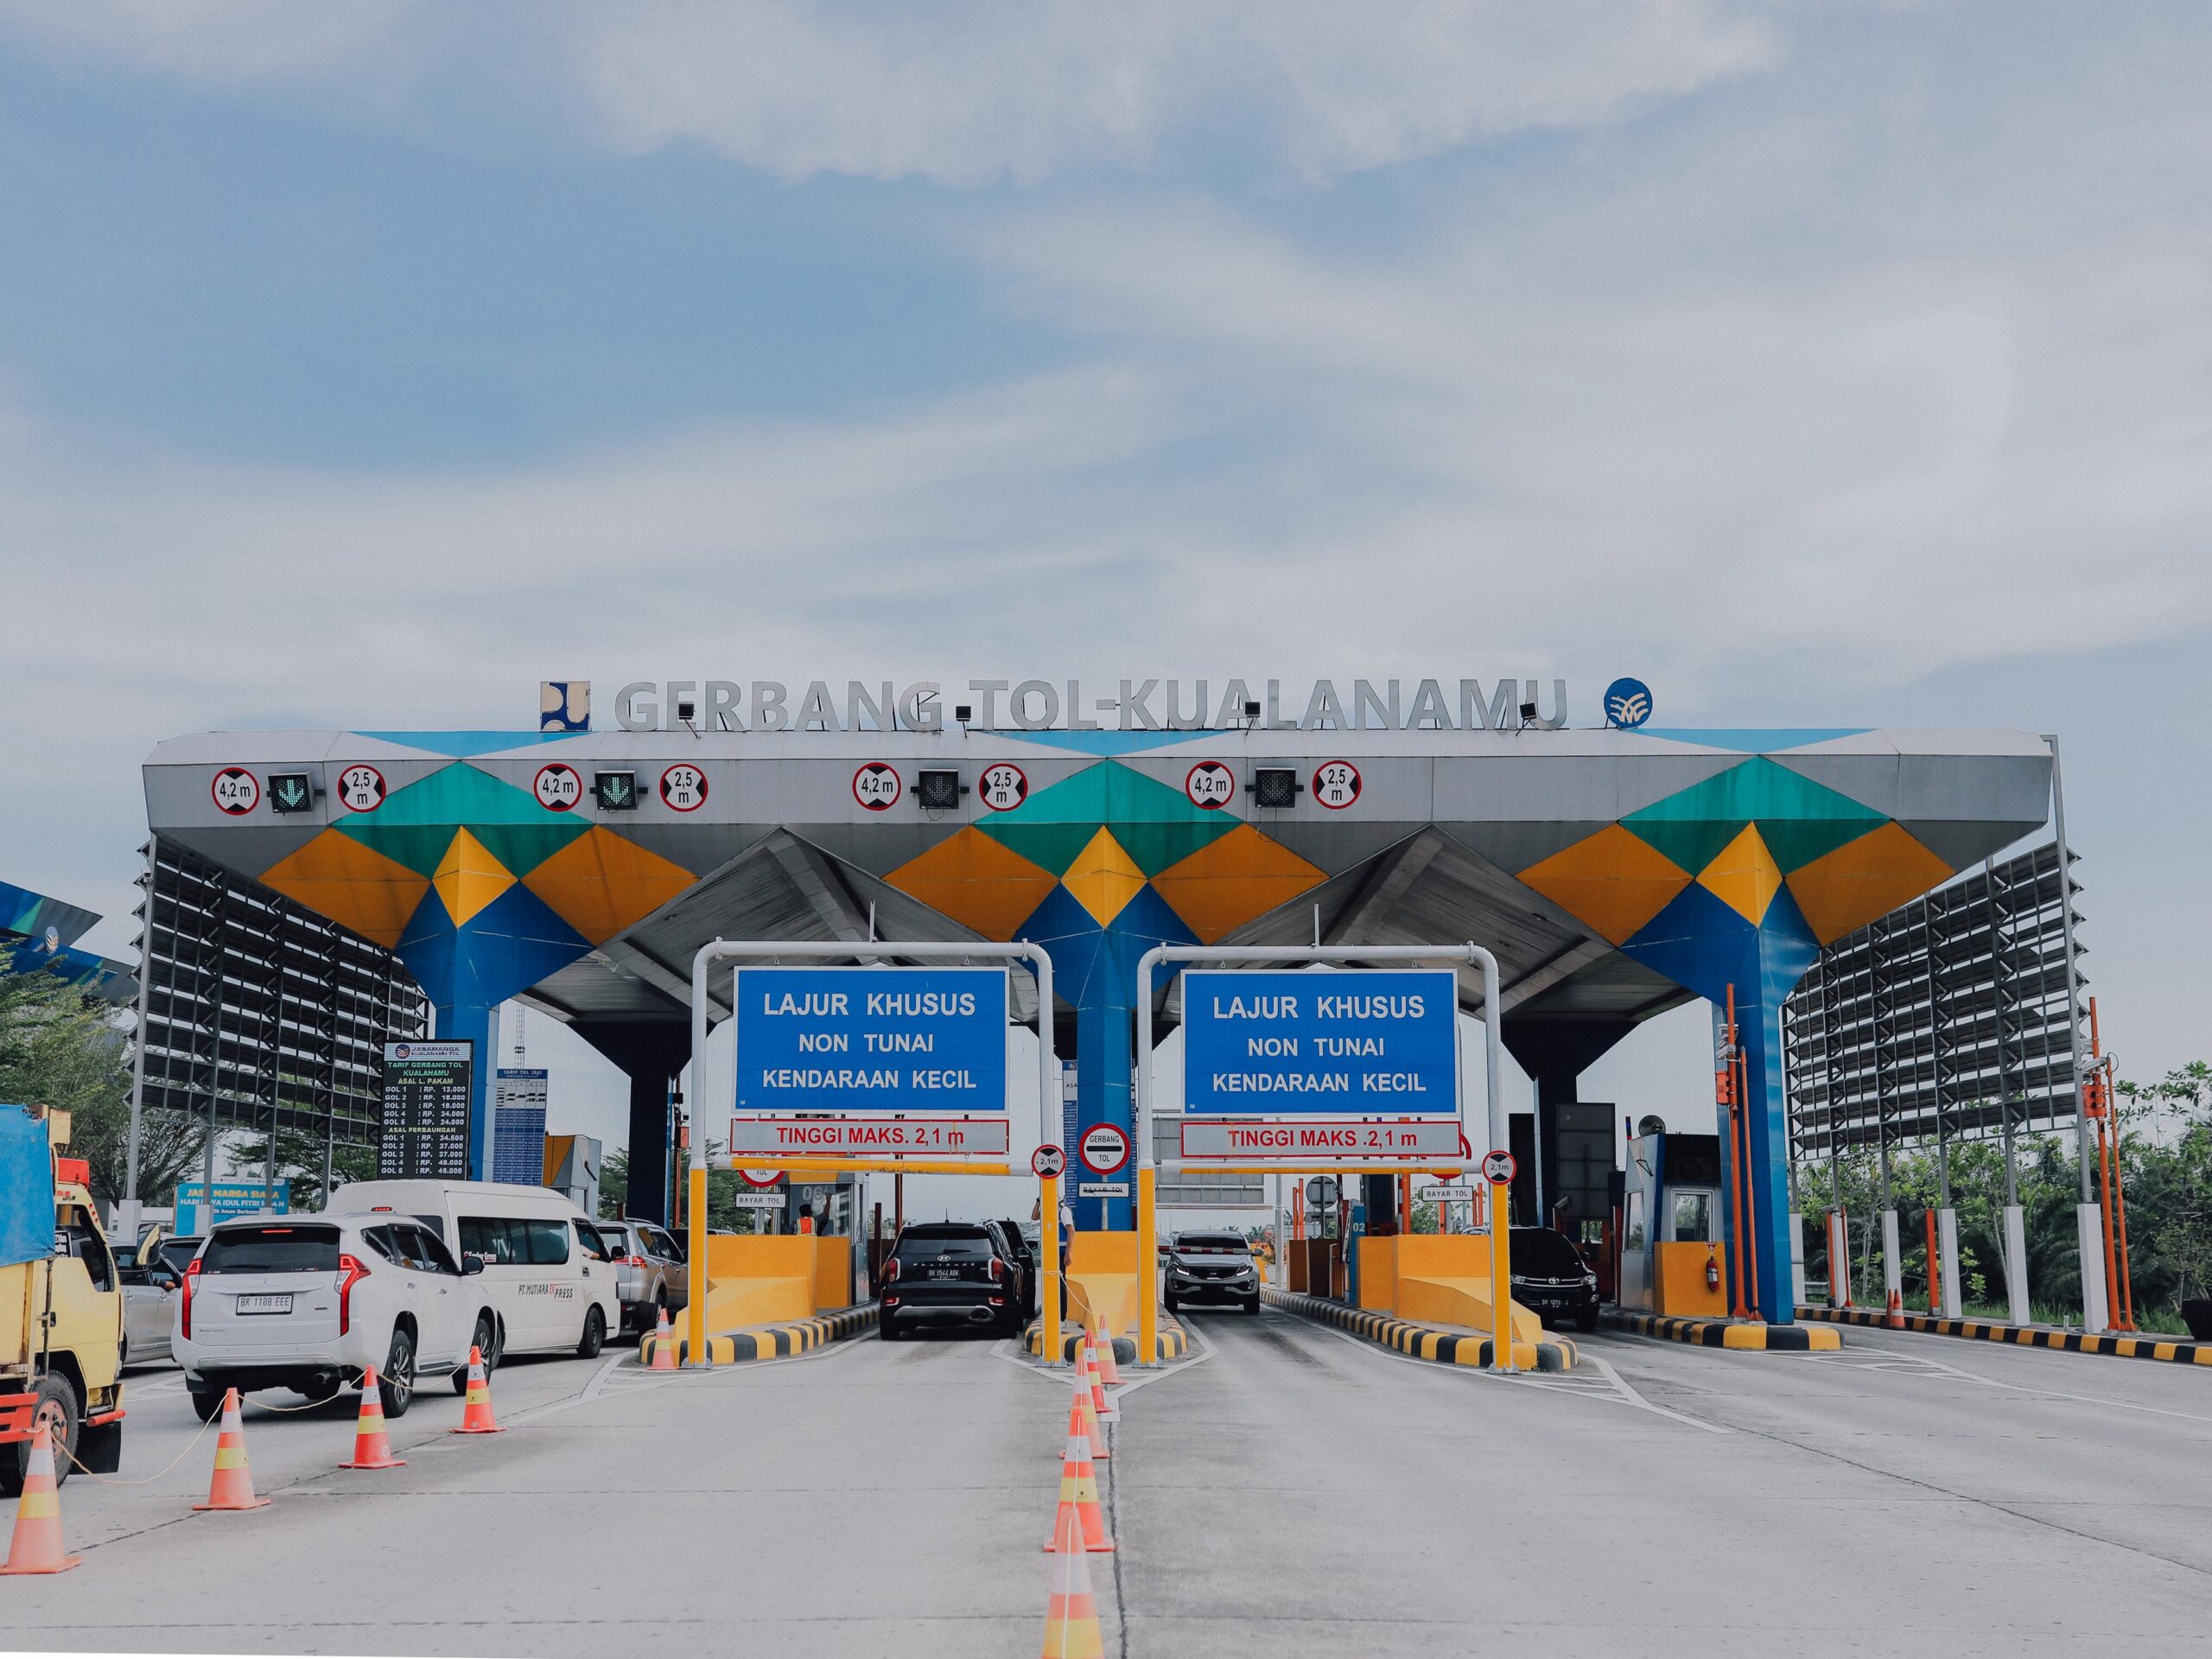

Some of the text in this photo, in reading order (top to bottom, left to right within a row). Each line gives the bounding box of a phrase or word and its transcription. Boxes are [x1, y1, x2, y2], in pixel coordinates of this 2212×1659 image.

[614, 681, 942, 732] GERBANG
[353, 772, 371, 790] 2,5
[674, 772, 693, 790] 2,5
[861, 778, 894, 795] 4,2 m
[993, 772, 1012, 788] 2,5
[1194, 776, 1227, 794] 4,2 m
[1328, 769, 1346, 786] 2,5
[219, 783, 251, 799] 4,2 m
[542, 778, 574, 796] 4,2 m
[1332, 790, 1343, 801] m
[356, 793, 368, 804] m
[678, 792, 690, 803] m
[996, 791, 1007, 802] m
[764, 993, 976, 1016] LAJUR KHUSUS
[1213, 995, 1425, 1019] LAJUR KHUSUS
[798, 1033, 934, 1052] NON TUNAI
[1248, 1038, 1384, 1057] NON TUNAI
[763, 1070, 976, 1089] KENDARAAN KECIL
[1212, 1073, 1427, 1092] KENDARAAN KECIL
[776, 1127, 964, 1147] TINGGI MAKS. 2,1 m
[1228, 1129, 1294, 1148] TINGGI
[1300, 1129, 1357, 1147] MAKS
[1401, 1133, 1417, 1147] m
[1353, 1223, 1365, 1231] 02
[240, 1297, 251, 1306] BK
[275, 1296, 289, 1306] EEE
